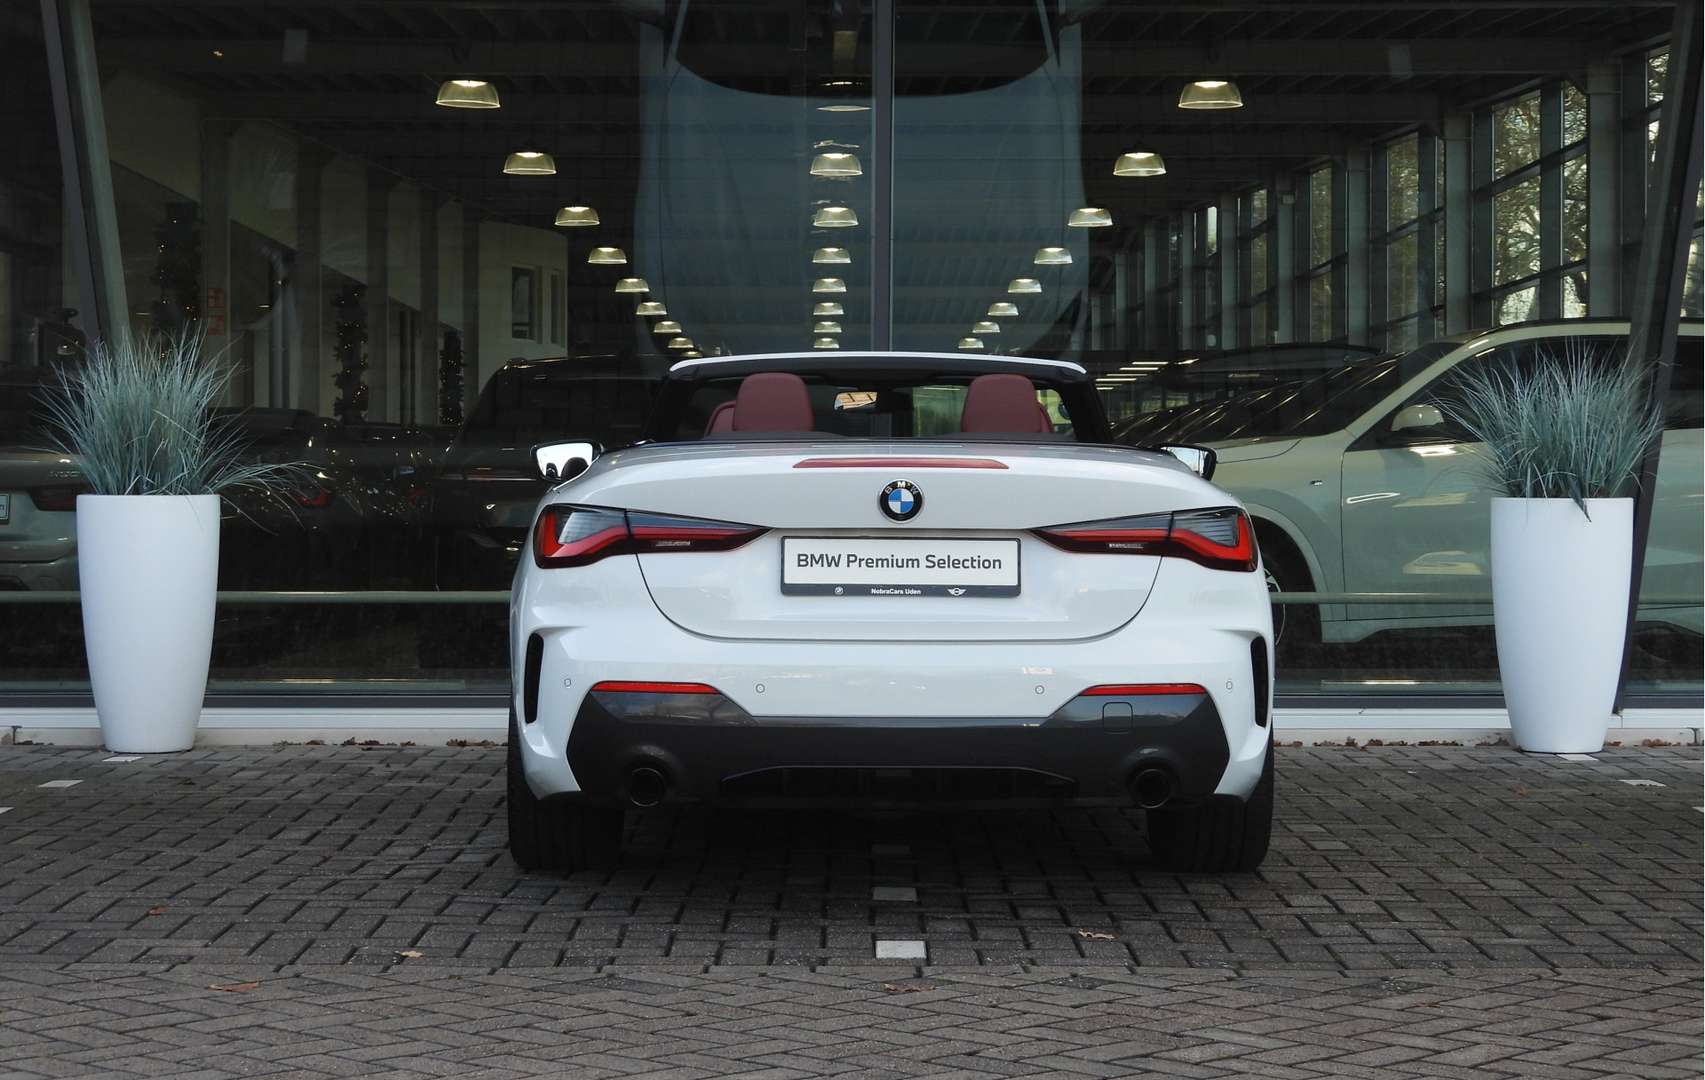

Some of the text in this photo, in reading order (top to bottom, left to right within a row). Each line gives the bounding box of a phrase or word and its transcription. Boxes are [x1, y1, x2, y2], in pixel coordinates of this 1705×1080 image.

[885, 480, 919, 495] BMW
[797, 553, 1002, 570] BMW Premium Selection
